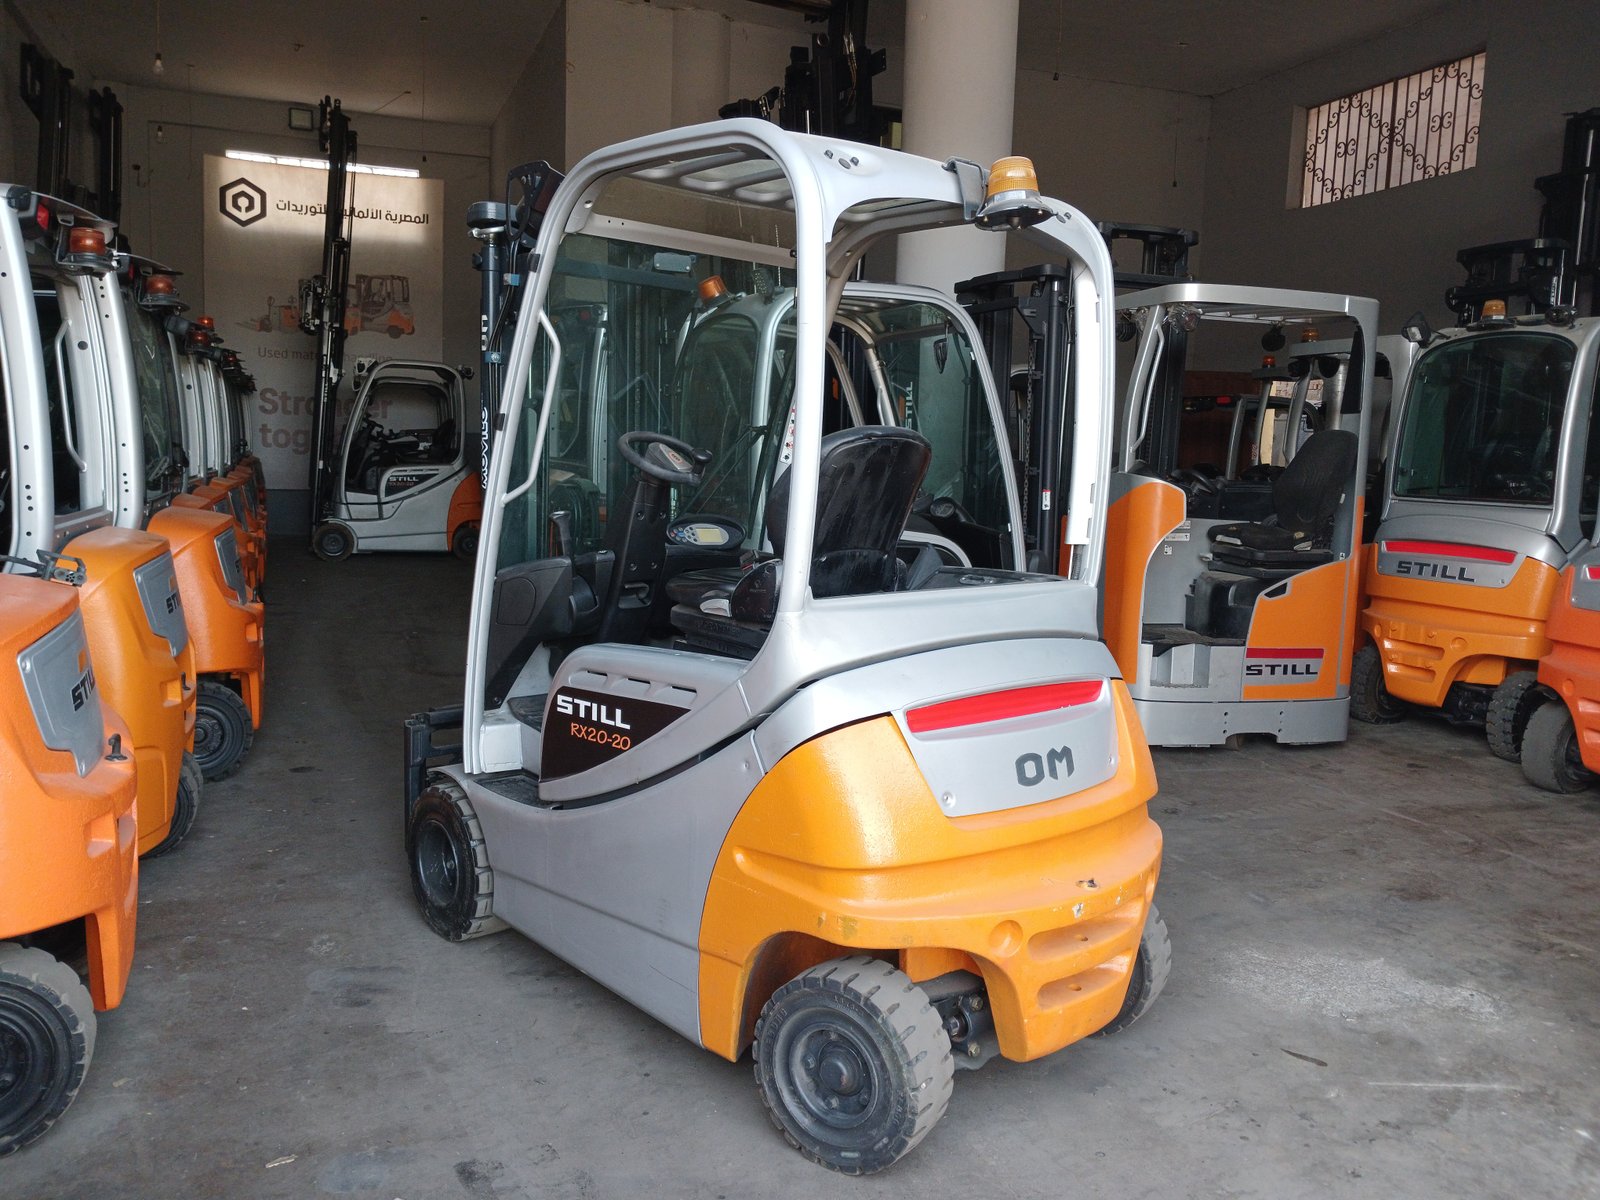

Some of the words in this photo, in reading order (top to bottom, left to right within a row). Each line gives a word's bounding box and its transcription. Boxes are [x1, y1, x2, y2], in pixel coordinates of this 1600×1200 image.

[276, 200, 328, 216] لتوريدات
[343, 204, 382, 220] الألماني
[385, 210, 429, 225] المصرية
[257, 347, 288, 359] Used
[904, 381, 913, 431] STILL
[1396, 560, 1475, 583] STILL
[1246, 664, 1318, 676] STILL
[71, 667, 95, 712] STIL
[556, 694, 631, 730] STILL
[570, 721, 631, 751] RX20-20
[1015, 745, 1075, 787] OM
